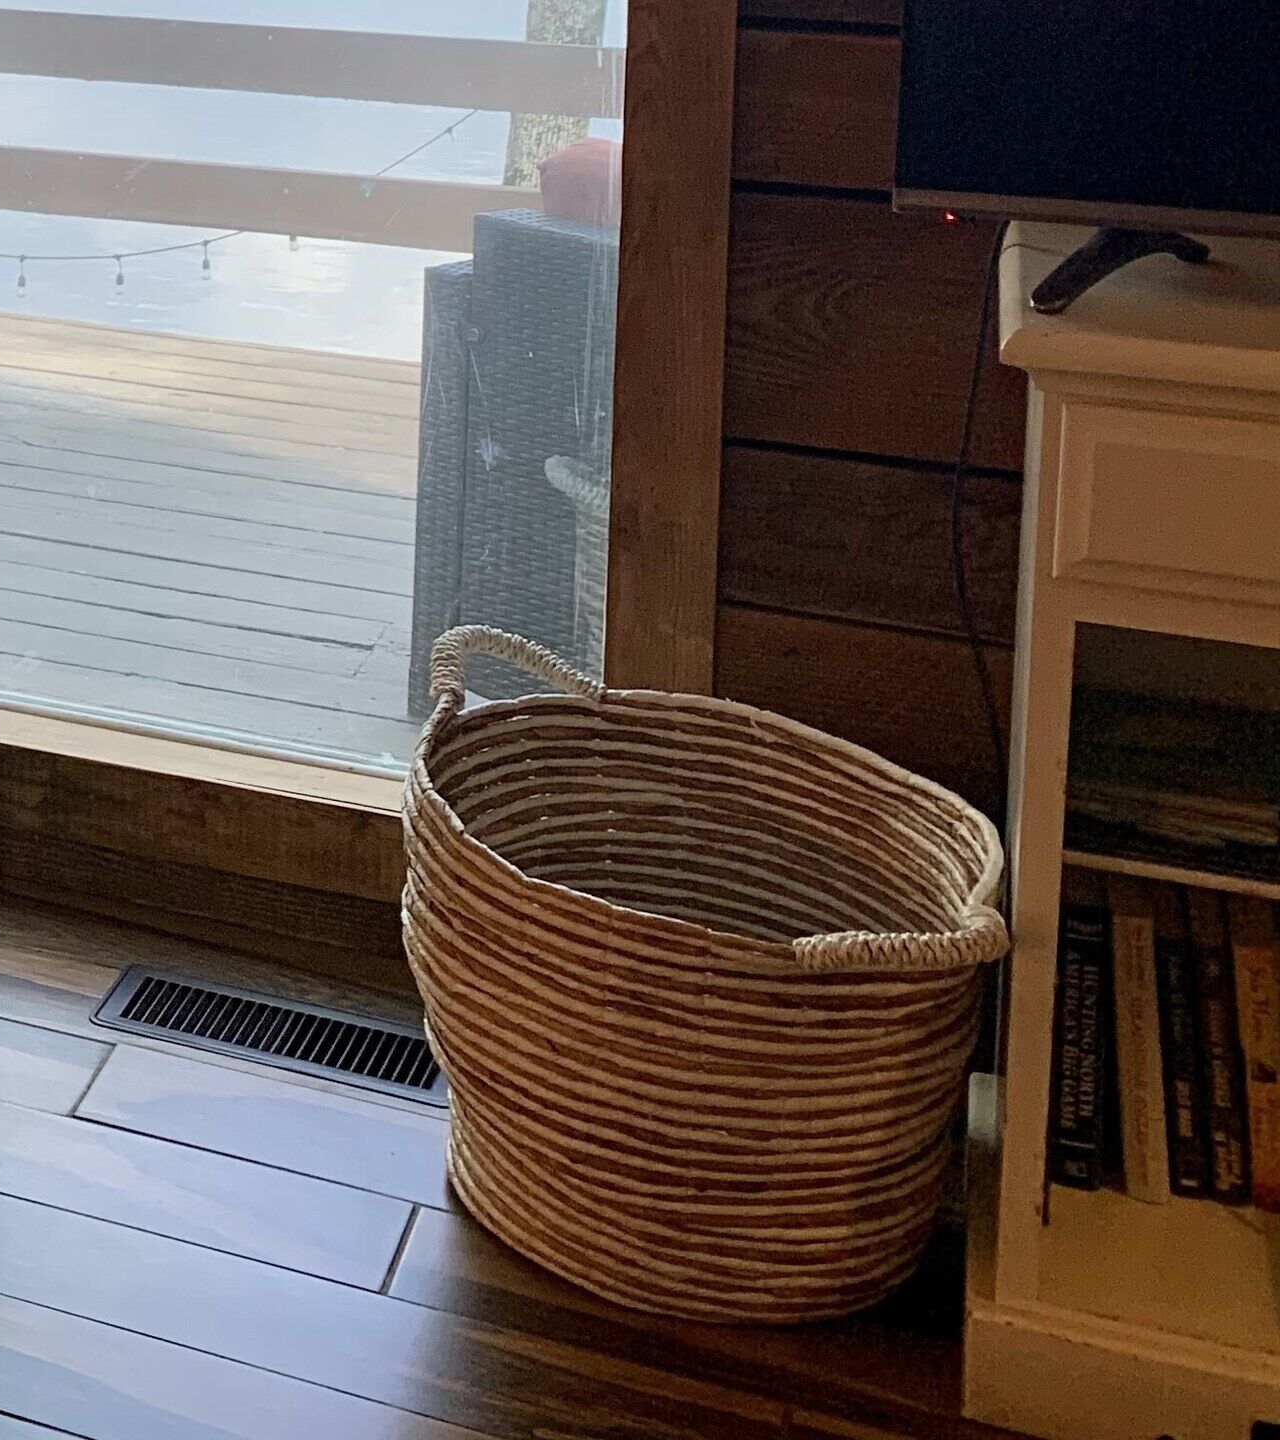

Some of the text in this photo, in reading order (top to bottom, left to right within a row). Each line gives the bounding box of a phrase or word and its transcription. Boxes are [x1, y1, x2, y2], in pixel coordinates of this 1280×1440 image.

[1062, 1044, 1079, 1076] BIG
[1078, 965, 1100, 1117] HUNTING NORTH
[1060, 1079, 1077, 1130] GAME
